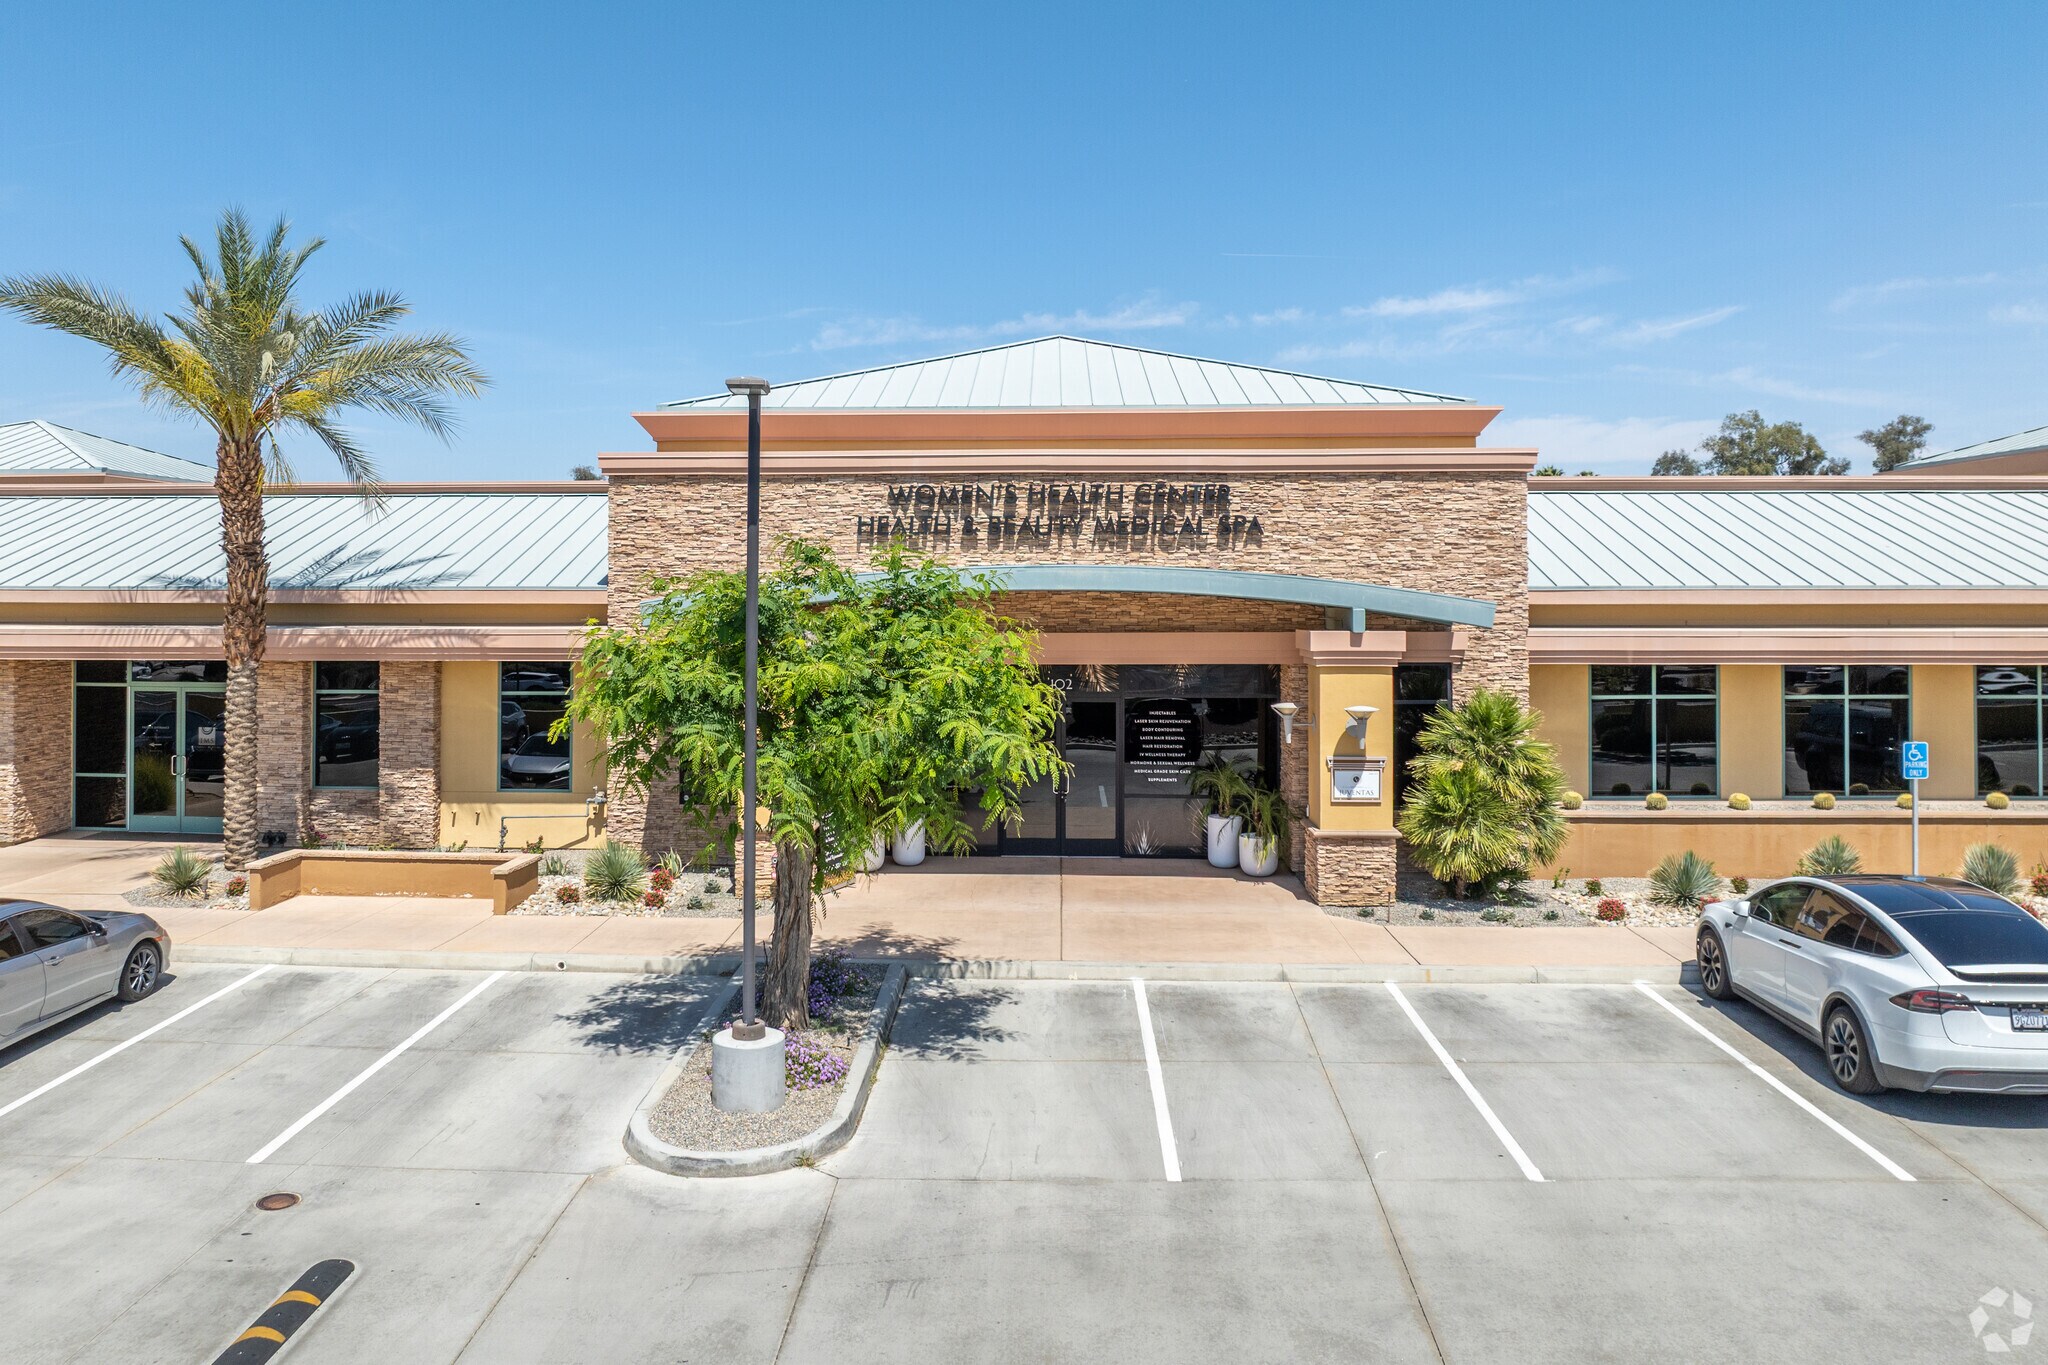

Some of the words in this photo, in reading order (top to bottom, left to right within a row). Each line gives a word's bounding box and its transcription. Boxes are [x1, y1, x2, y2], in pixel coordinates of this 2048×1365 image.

[888, 484, 1018, 505] WOMEN'S
[1027, 484, 1124, 505] HEALTH
[1134, 483, 1231, 505] CENTER
[857, 516, 950, 536] HEALTH
[963, 515, 978, 536] &
[989, 515, 1083, 538] BEAUTY
[1093, 515, 1209, 536] MEDICAL
[1218, 515, 1264, 536] SPA
[1051, 679, 1073, 690] 102
[1910, 769, 1923, 777] ONLY
